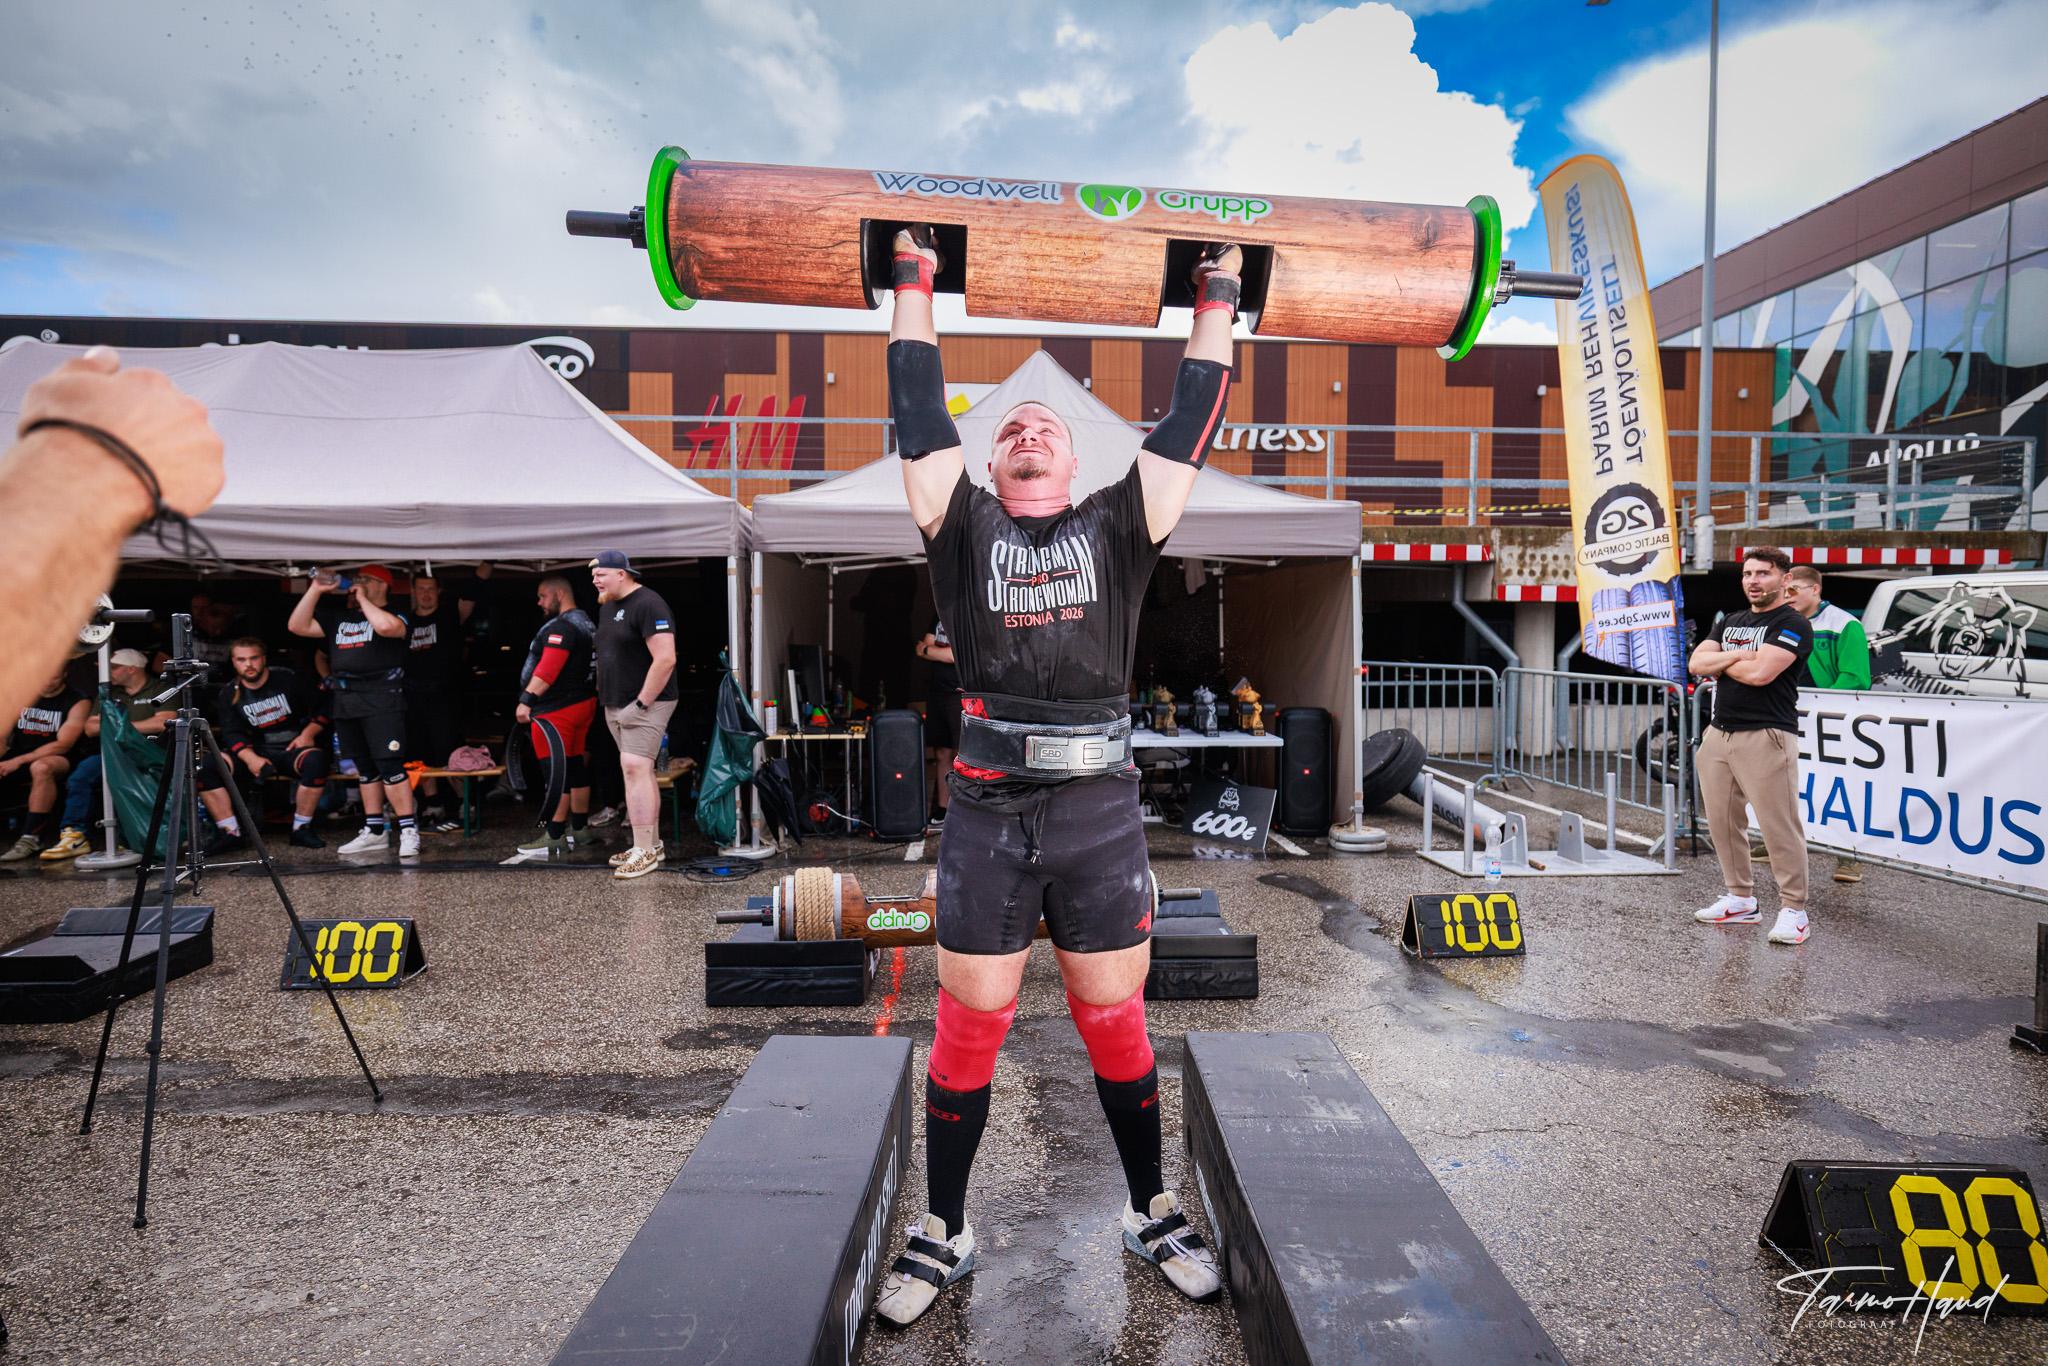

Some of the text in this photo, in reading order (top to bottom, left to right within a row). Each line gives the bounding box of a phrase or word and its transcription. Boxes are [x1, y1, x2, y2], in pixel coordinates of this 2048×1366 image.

[875, 172, 1268, 220] Woodwell Grupp
[989, 534, 1095, 581] STRONGMAN
[988, 569, 1097, 613] STRONGWOMAN
[1031, 573, 1049, 587] PRO
[1004, 606, 1084, 628] ESTONIA 2026
[1041, 749, 1062, 759] SBD
[1192, 810, 1257, 841] 600€
[869, 911, 928, 930] Grupp
[1440, 893, 1522, 952] 100
[309, 921, 404, 983] 100
[1889, 1174, 2048, 1305] 80
